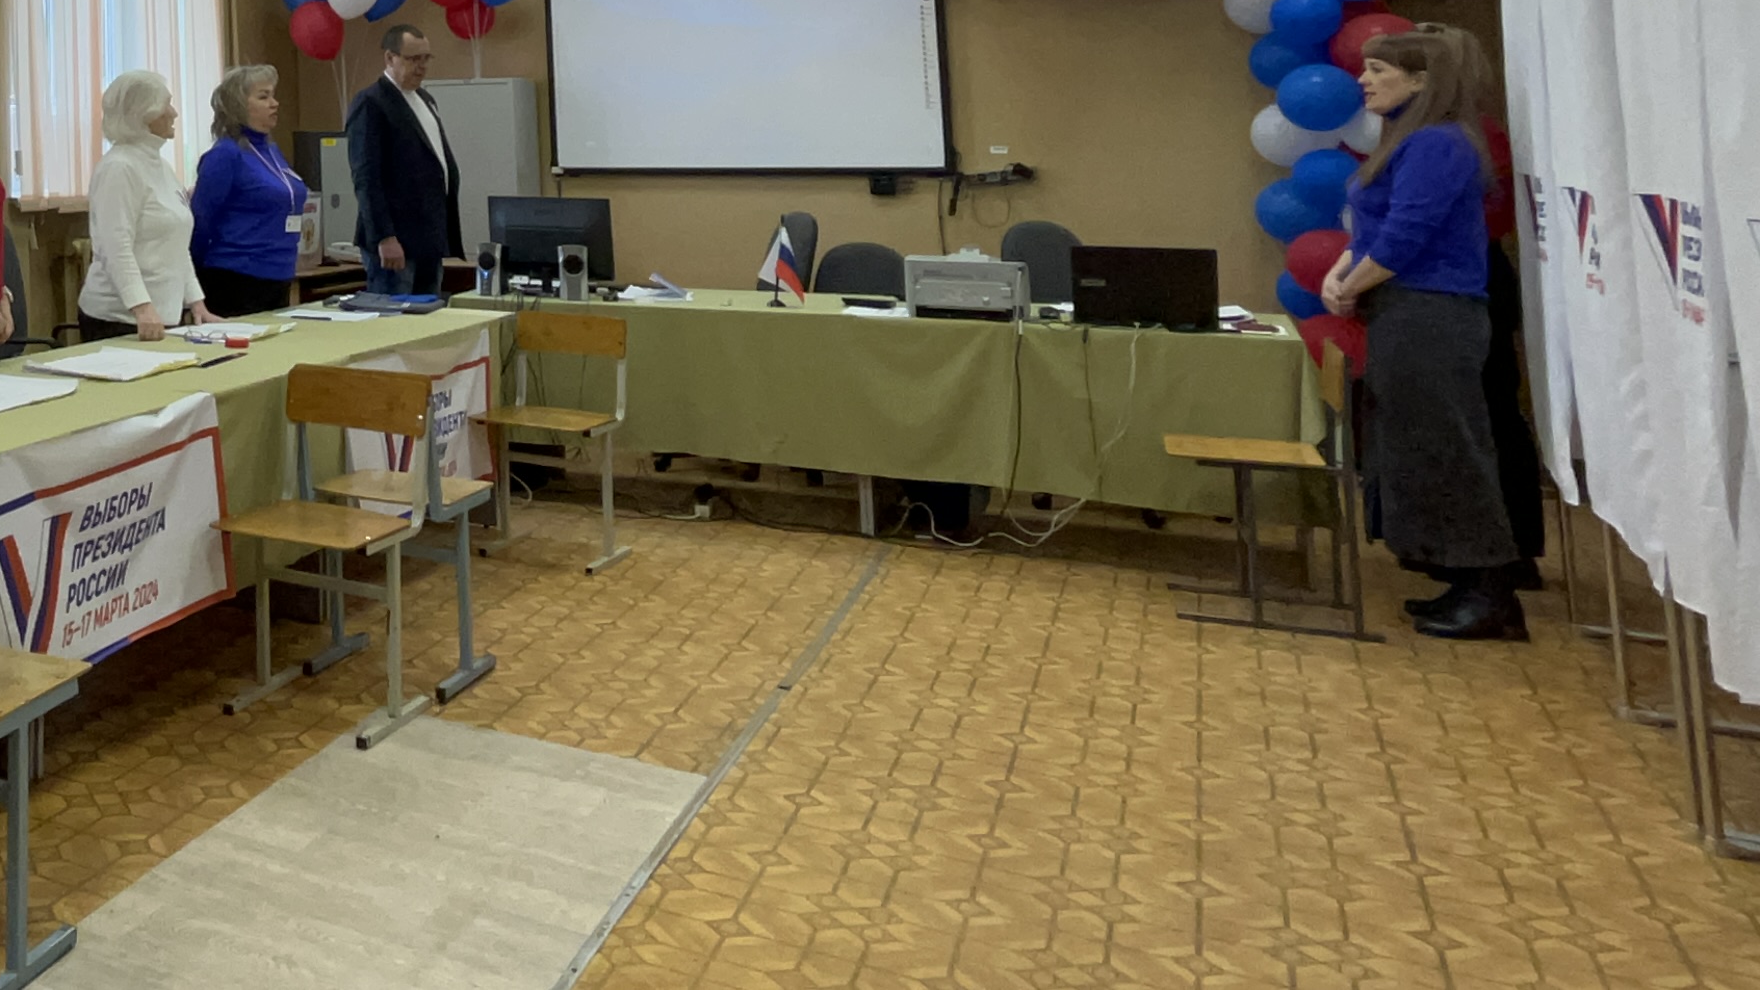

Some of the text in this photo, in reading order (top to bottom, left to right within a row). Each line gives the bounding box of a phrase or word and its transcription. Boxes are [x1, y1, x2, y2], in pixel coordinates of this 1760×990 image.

[79, 481, 153, 533] ВЫБОРЫ
[71, 507, 166, 572] ПРЕЗИДЕНТА
[66, 558, 129, 614] РОССИИ
[93, 592, 130, 631] МАРТА
[131, 579, 159, 612] 2024
